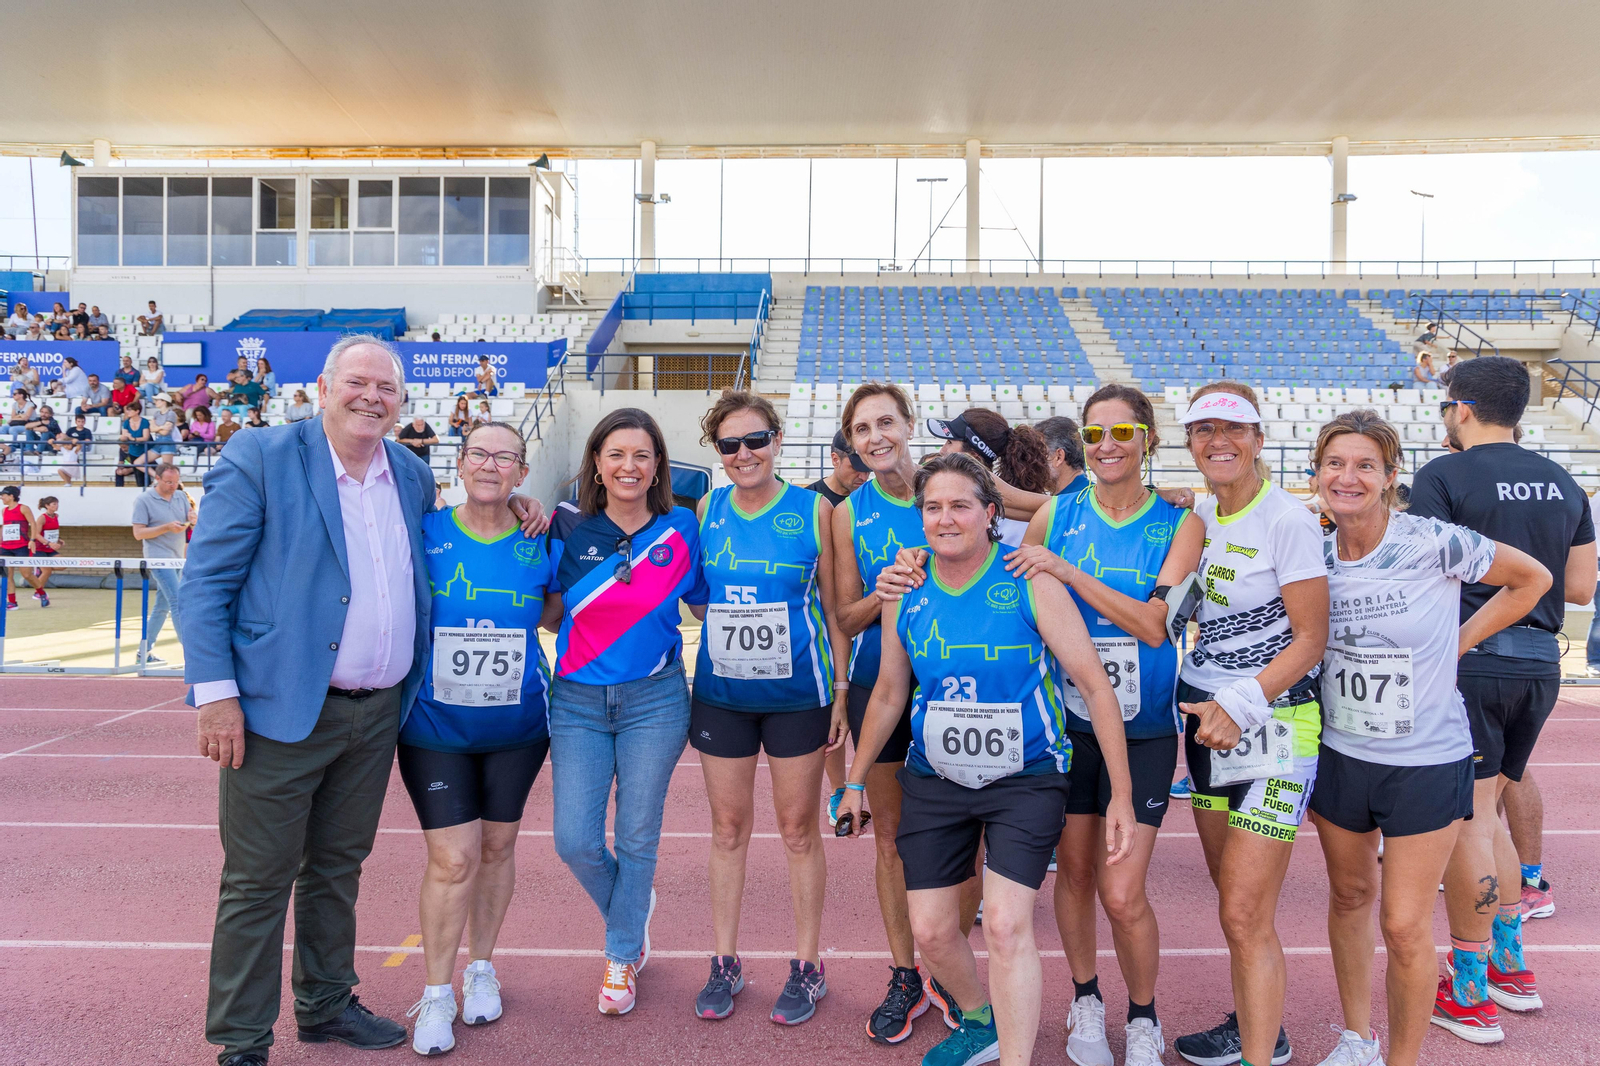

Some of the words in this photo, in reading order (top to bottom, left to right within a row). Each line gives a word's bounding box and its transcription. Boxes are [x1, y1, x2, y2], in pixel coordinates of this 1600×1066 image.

[412, 353, 438, 365] SAN
[441, 353, 508, 365] FERNADO
[412, 366, 441, 377] CLUB
[1495, 482, 1564, 501] ROTA
[579, 554, 604, 562] VIATOR
[1207, 564, 1236, 582] CARROS
[1206, 576, 1215, 590] DE
[725, 584, 758, 605] 55
[1206, 589, 1229, 607] FUEGO
[1332, 590, 1407, 610] EMORIAL
[1329, 609, 1353, 617] RGENTO
[1355, 612, 1388, 622] CARMONA
[721, 625, 774, 651] 709
[452, 649, 509, 677] 975
[941, 676, 978, 703] 23
[1335, 668, 1391, 704] 107
[941, 726, 1005, 757] 606
[1265, 787, 1279, 799] DE
[1267, 778, 1303, 794] CARROS
[1262, 798, 1294, 814] FUEGO
